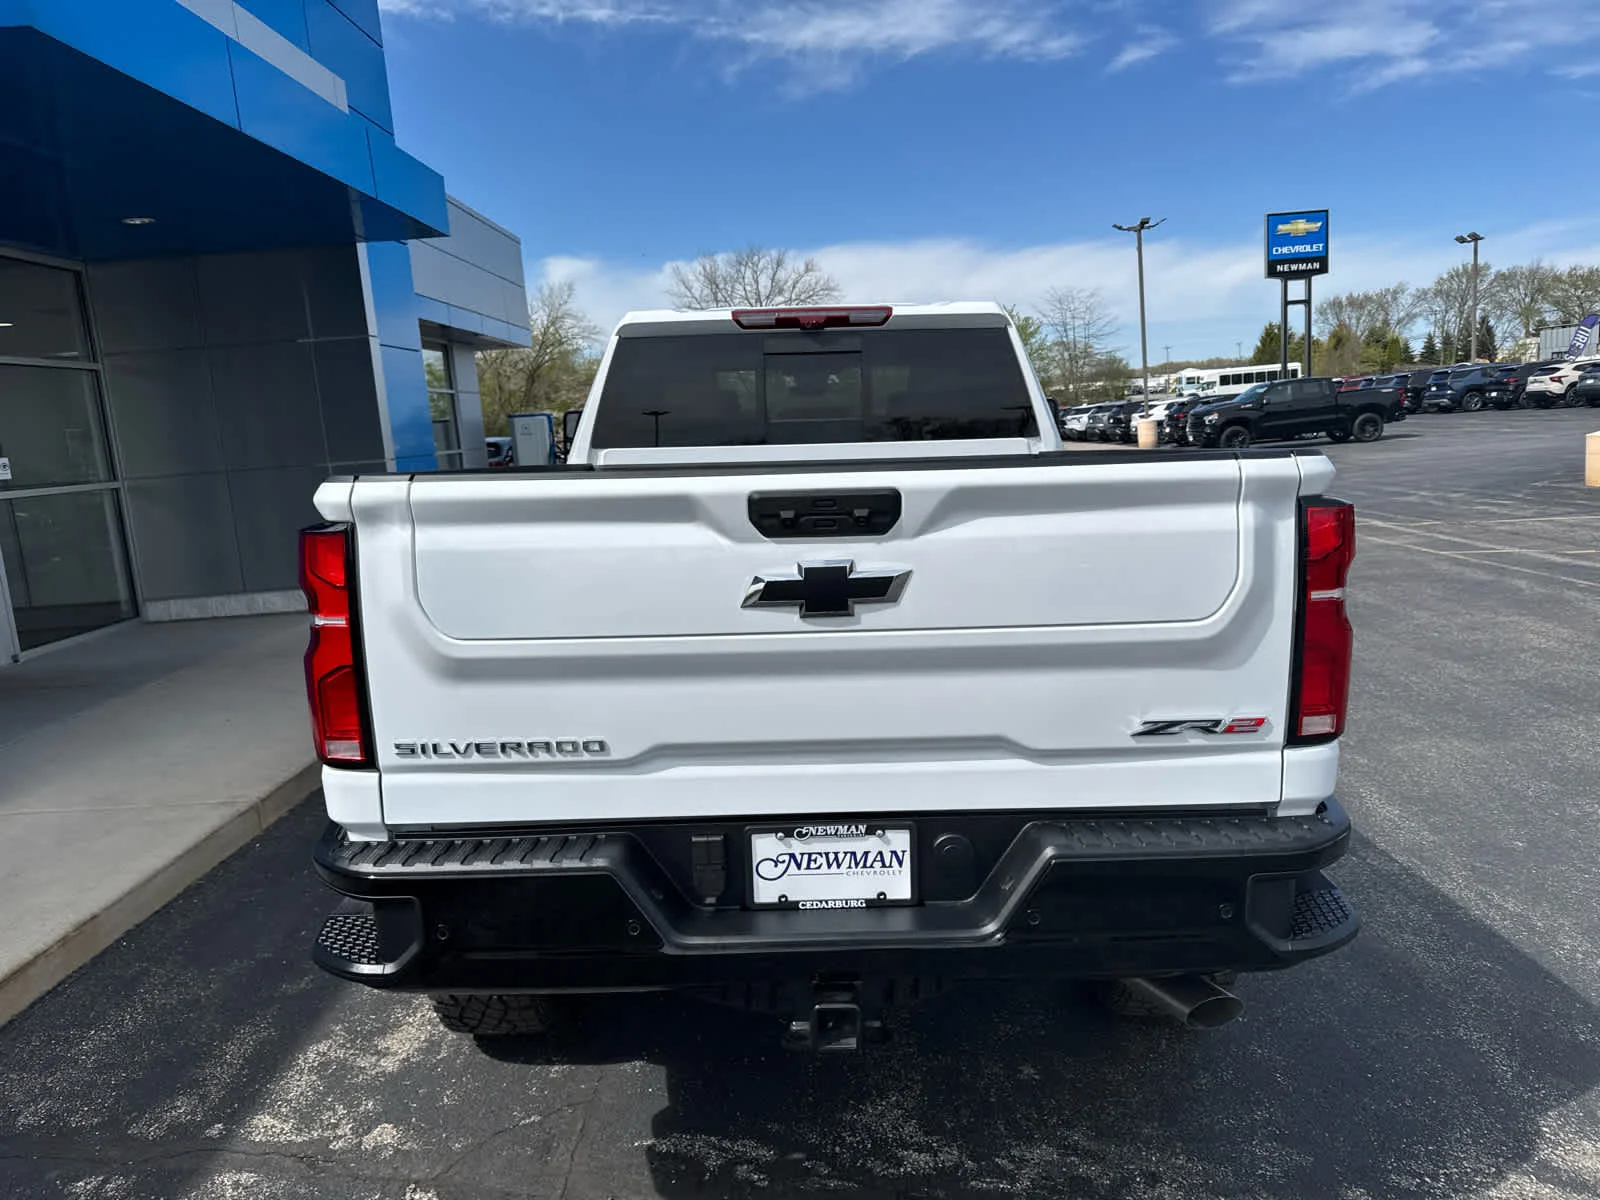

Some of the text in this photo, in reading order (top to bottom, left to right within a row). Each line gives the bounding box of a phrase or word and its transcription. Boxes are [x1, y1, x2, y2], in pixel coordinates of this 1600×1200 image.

[1272, 243, 1324, 255] CHEVROLET
[1276, 262, 1320, 272] NEWMAN
[1130, 717, 1267, 737] ZR2
[393, 739, 606, 756] SILVERADO
[793, 824, 867, 841] NEWMAN
[755, 849, 908, 881] NEWMAN
[845, 869, 903, 877] CHEVROLET
[798, 899, 867, 910] CEDARBURG
